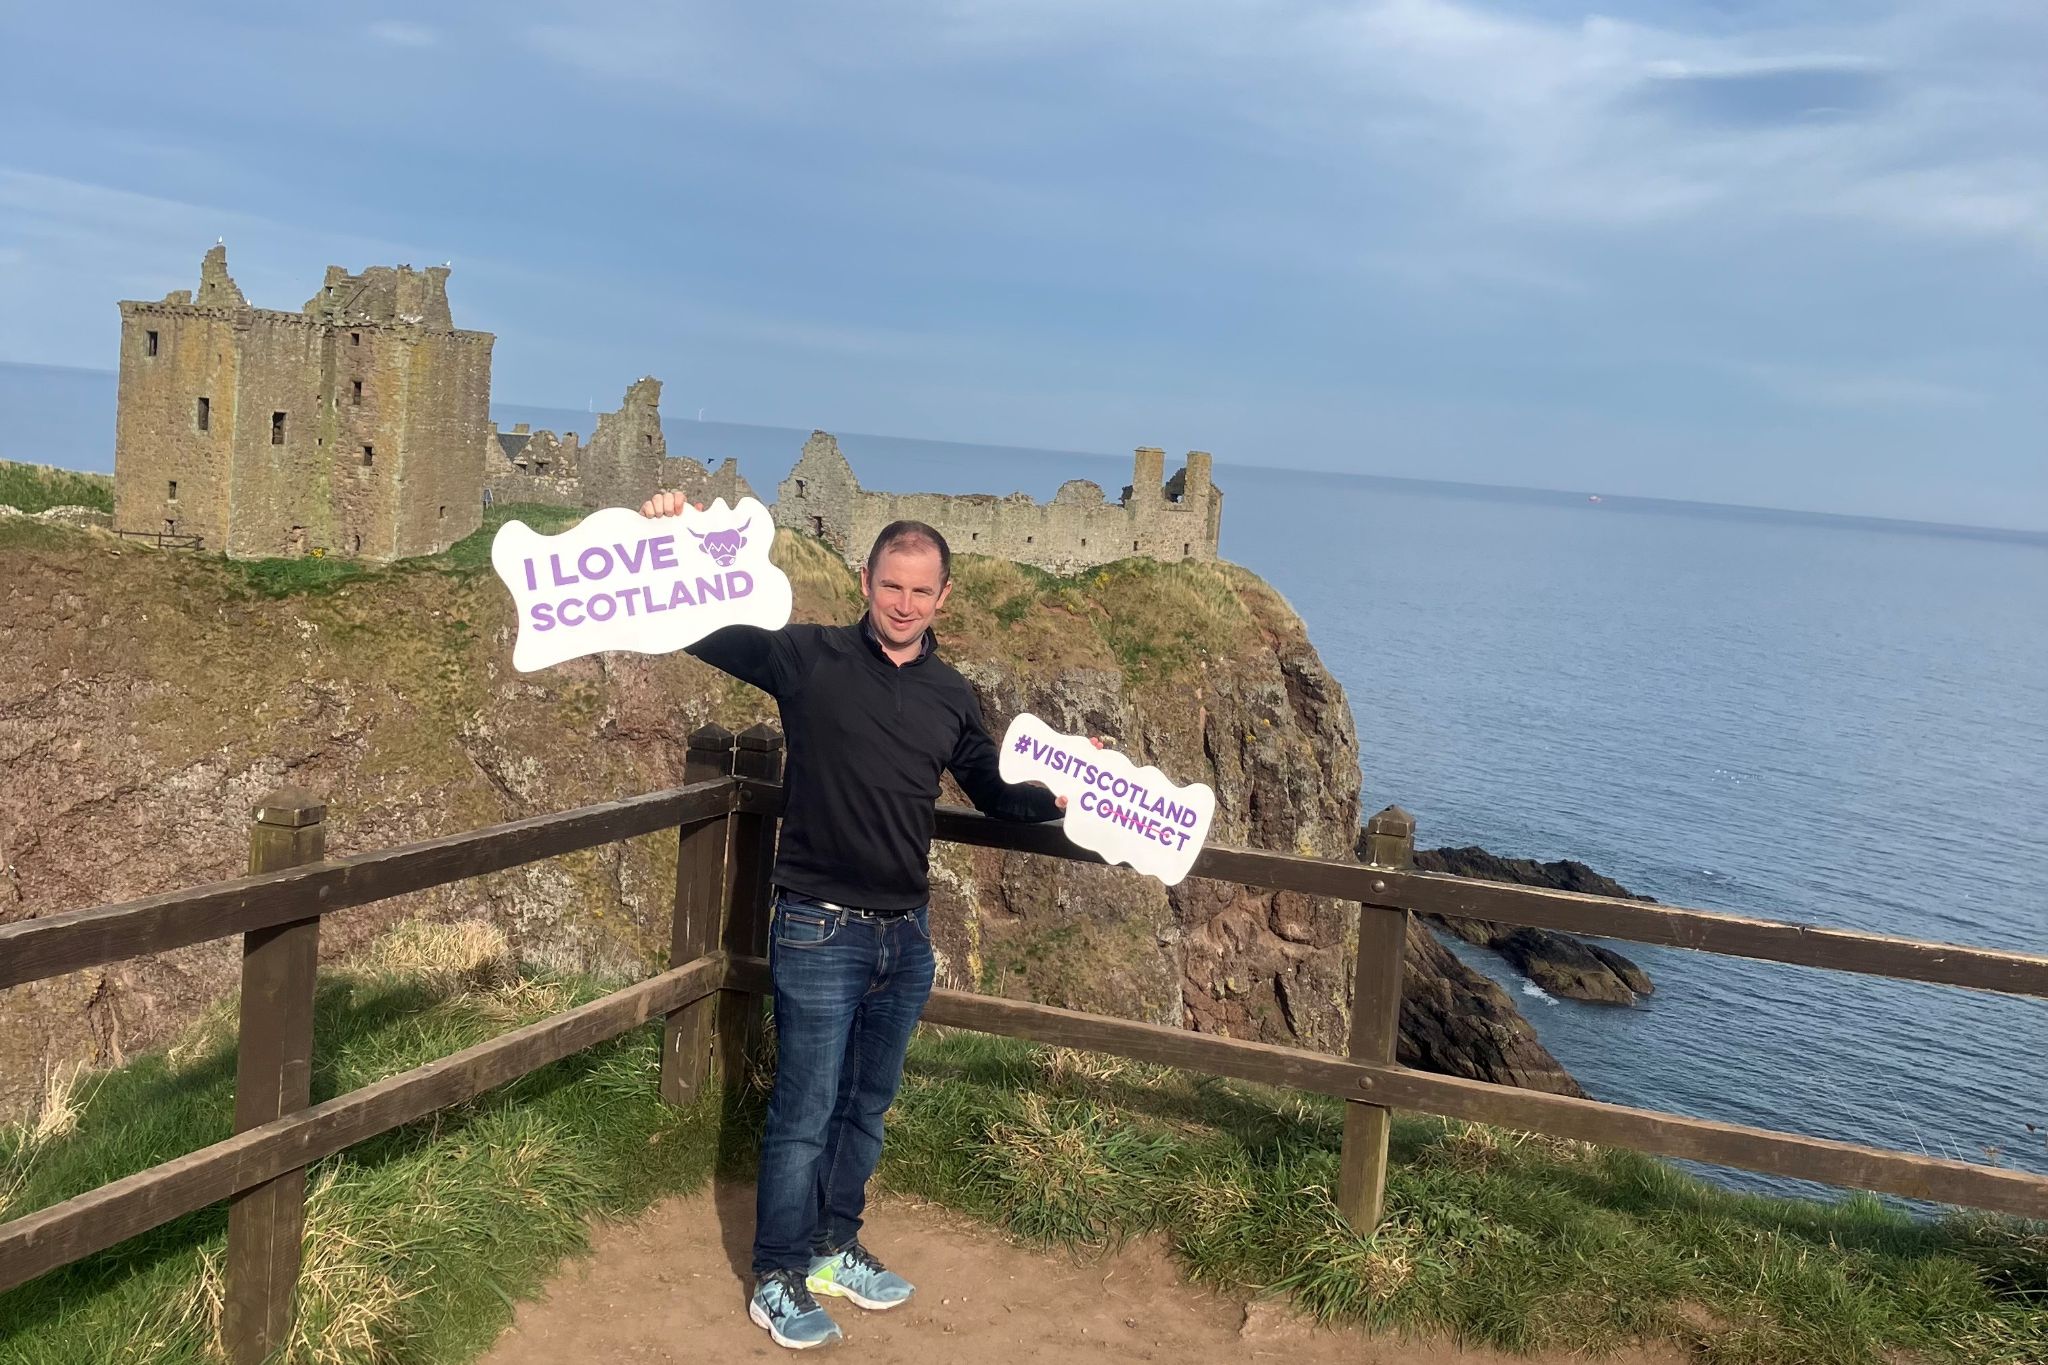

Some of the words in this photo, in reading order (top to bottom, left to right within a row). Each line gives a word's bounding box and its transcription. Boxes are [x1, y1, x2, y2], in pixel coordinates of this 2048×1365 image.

[523, 558, 537, 591] I
[550, 535, 679, 586] LOVE
[530, 570, 754, 632] SCOTLAND
[1014, 734, 1197, 828] #VISITSCOTLAND
[1080, 791, 1191, 852] CONNECT
